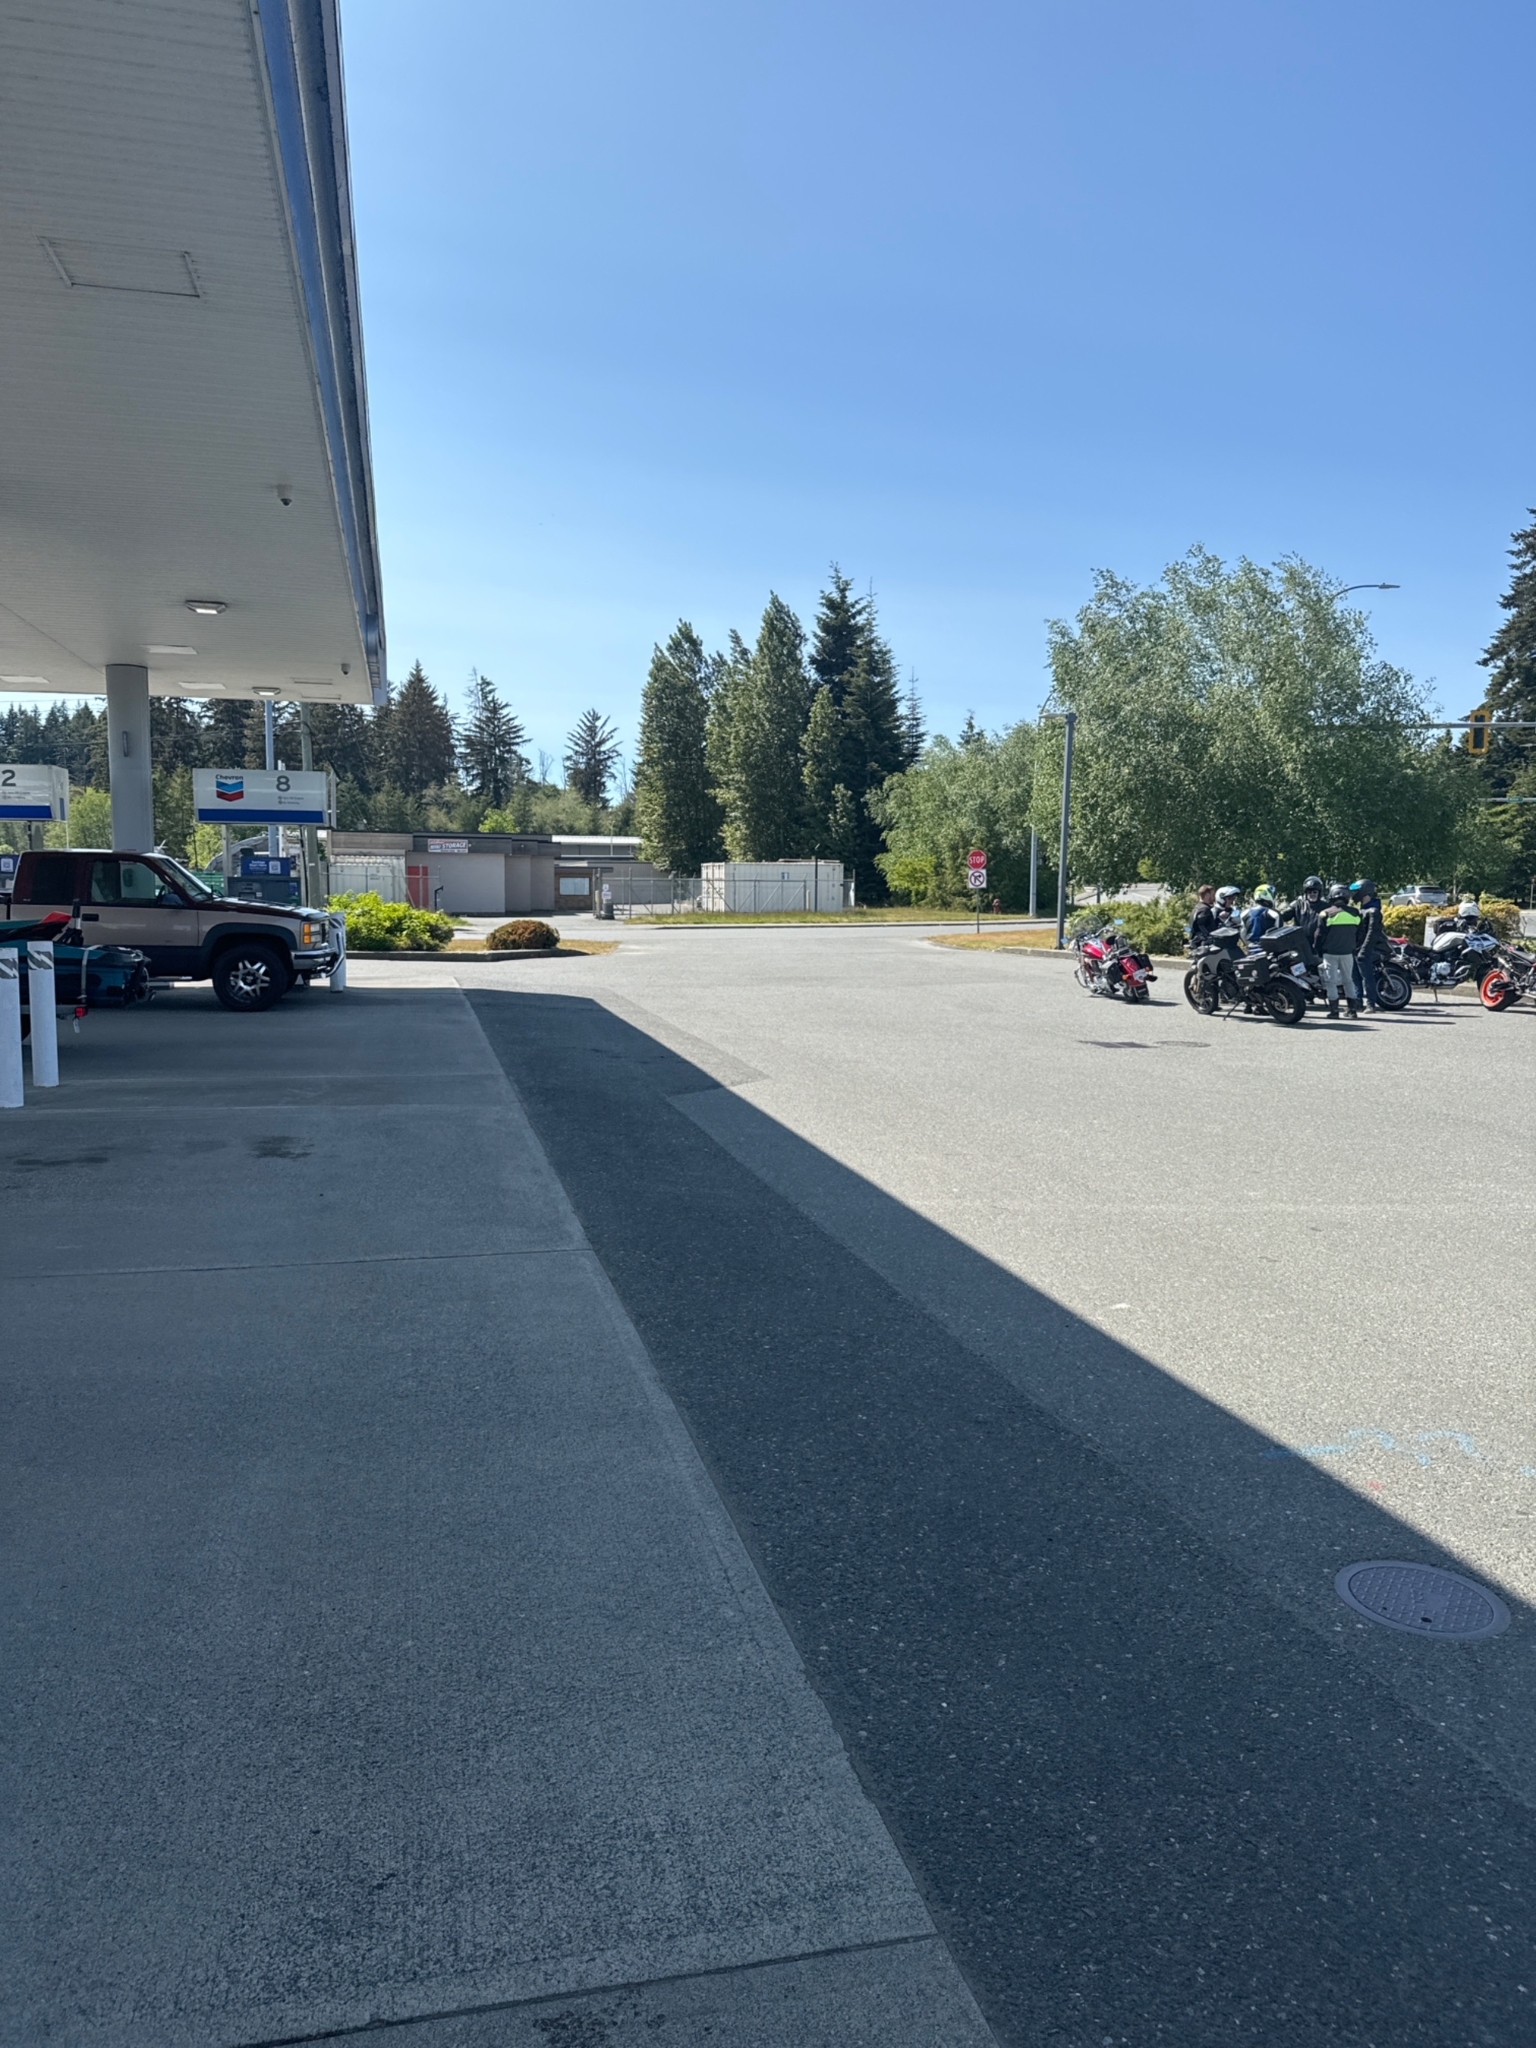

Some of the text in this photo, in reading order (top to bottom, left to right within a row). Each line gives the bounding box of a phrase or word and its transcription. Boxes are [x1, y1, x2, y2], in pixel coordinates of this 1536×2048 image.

[2, 769, 16, 787] 2
[276, 775, 291, 792] 8
[969, 856, 985, 864] STOP
